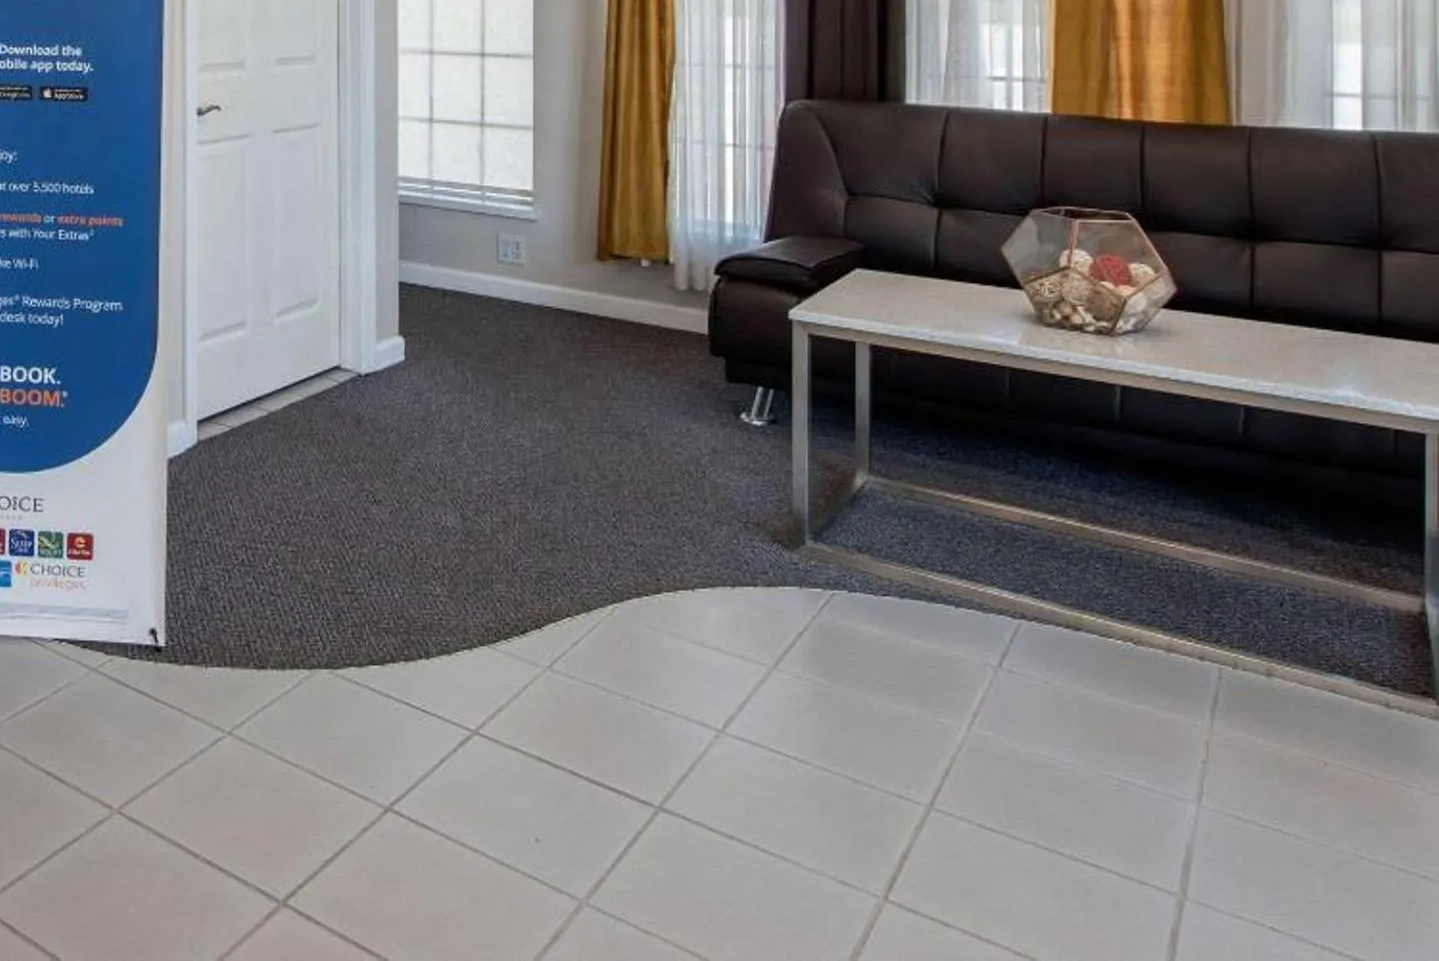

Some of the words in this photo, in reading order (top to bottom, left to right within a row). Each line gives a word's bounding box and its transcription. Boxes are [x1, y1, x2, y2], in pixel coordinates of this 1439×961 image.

[0, 44, 59, 56] Download
[62, 45, 83, 56] the
[30, 61, 54, 73] app
[56, 61, 94, 73] today.
[43, 215, 55, 224] or
[22, 296, 71, 309] Rewards
[73, 298, 123, 313] Program
[0, 311, 25, 323] desk
[27, 313, 64, 328] today!
[0, 365, 61, 384] BOOK.
[30, 563, 87, 578] CHOICE
